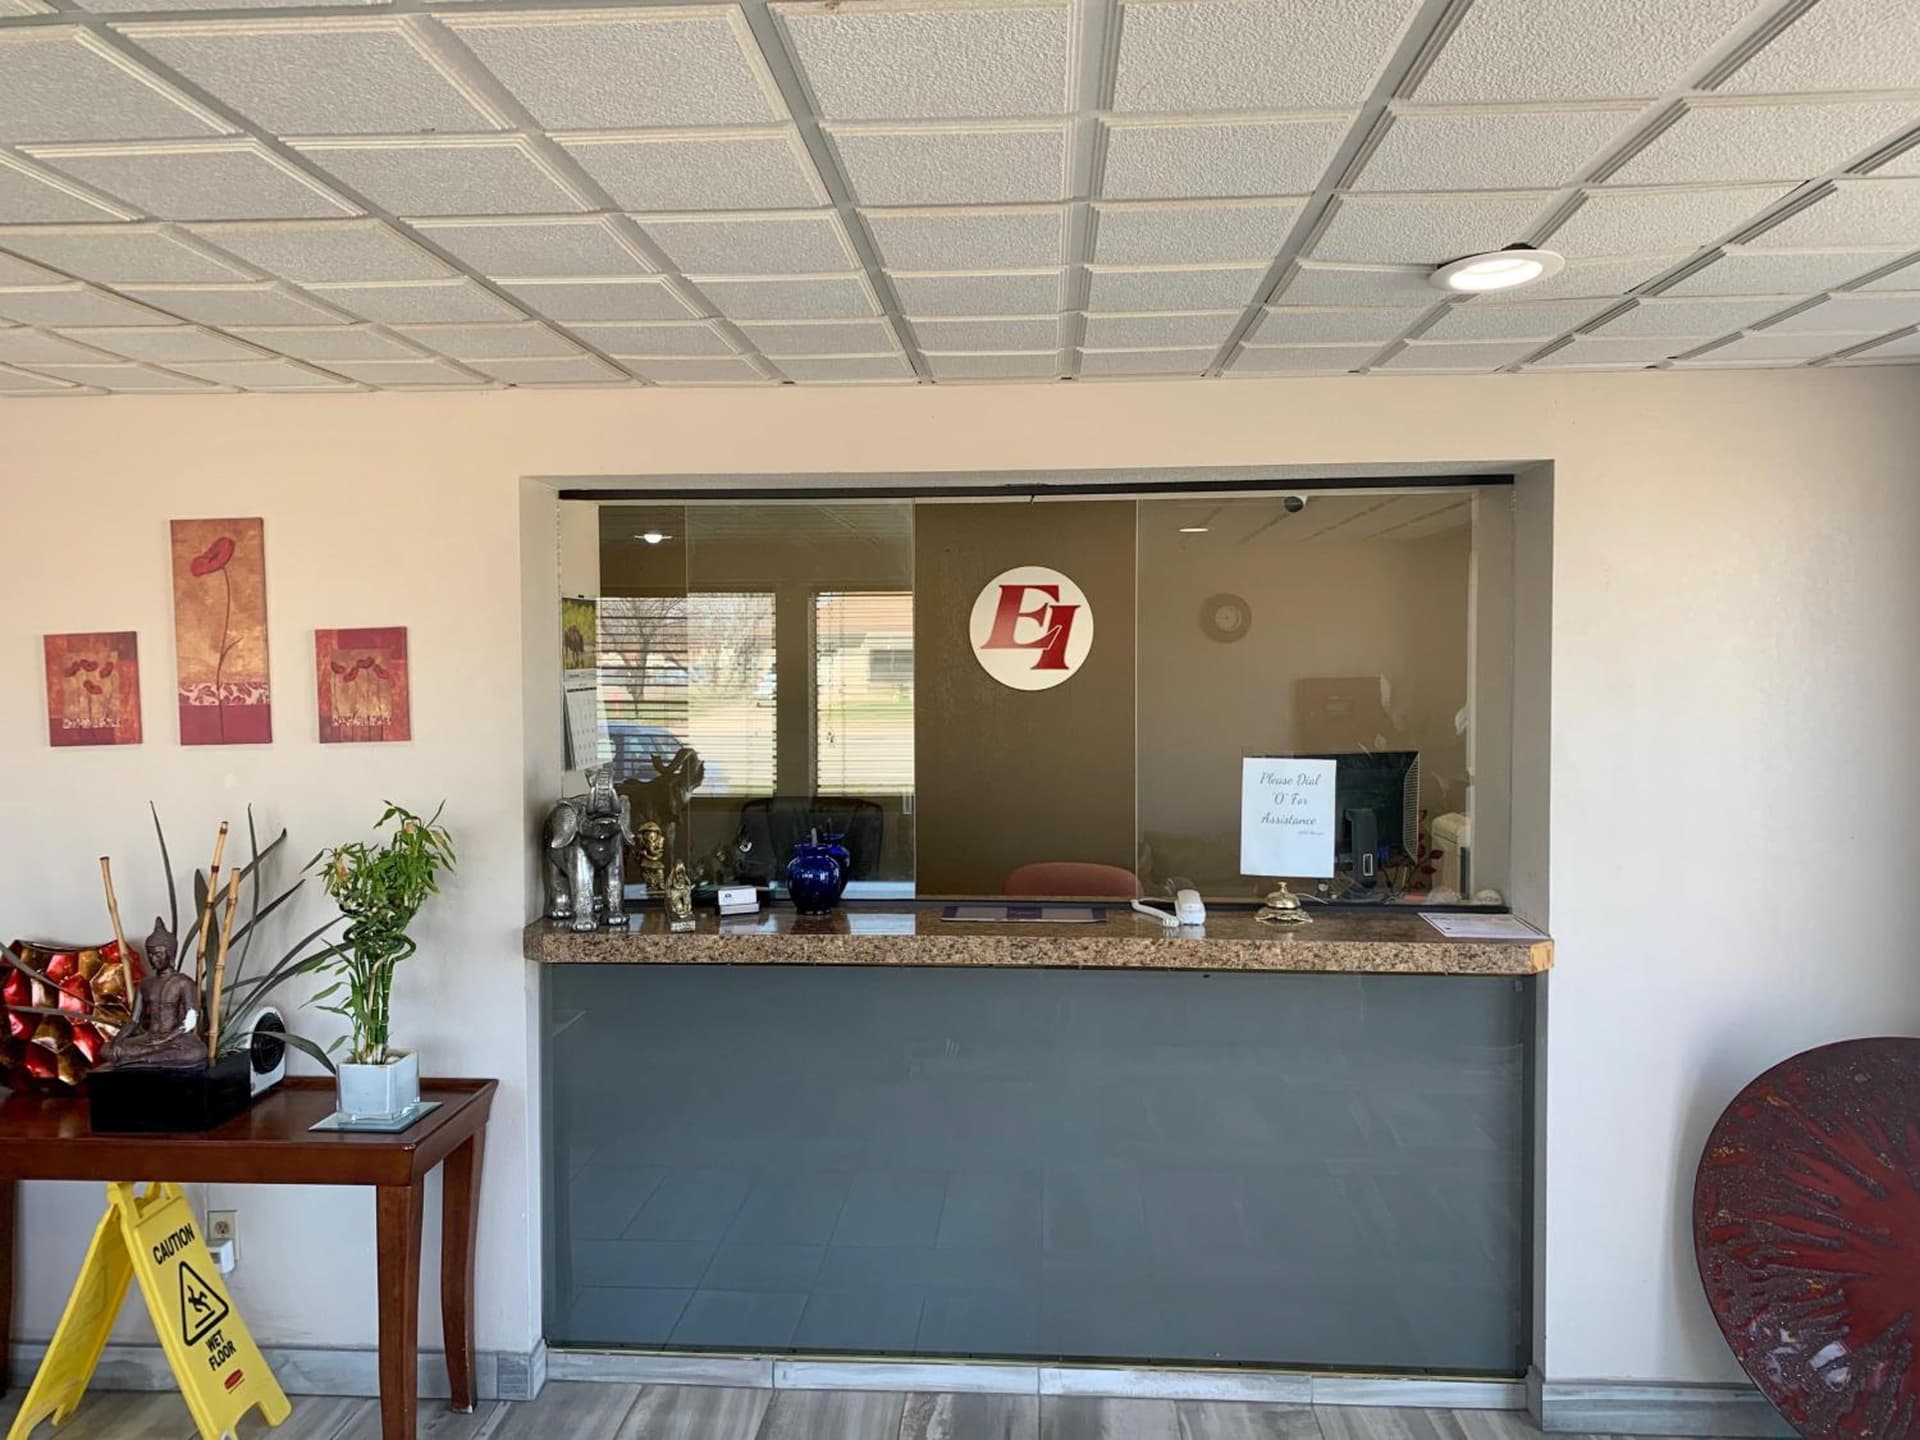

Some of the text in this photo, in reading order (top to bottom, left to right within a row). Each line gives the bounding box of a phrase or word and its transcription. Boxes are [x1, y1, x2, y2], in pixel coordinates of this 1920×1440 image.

[1260, 771, 1321, 786] Please Dial
[1291, 792, 1307, 805] For
[1261, 811, 1316, 825] Assistance
[153, 1223, 195, 1265] CAUTION
[205, 1330, 225, 1352] WET
[208, 1341, 236, 1371] FLOOR
